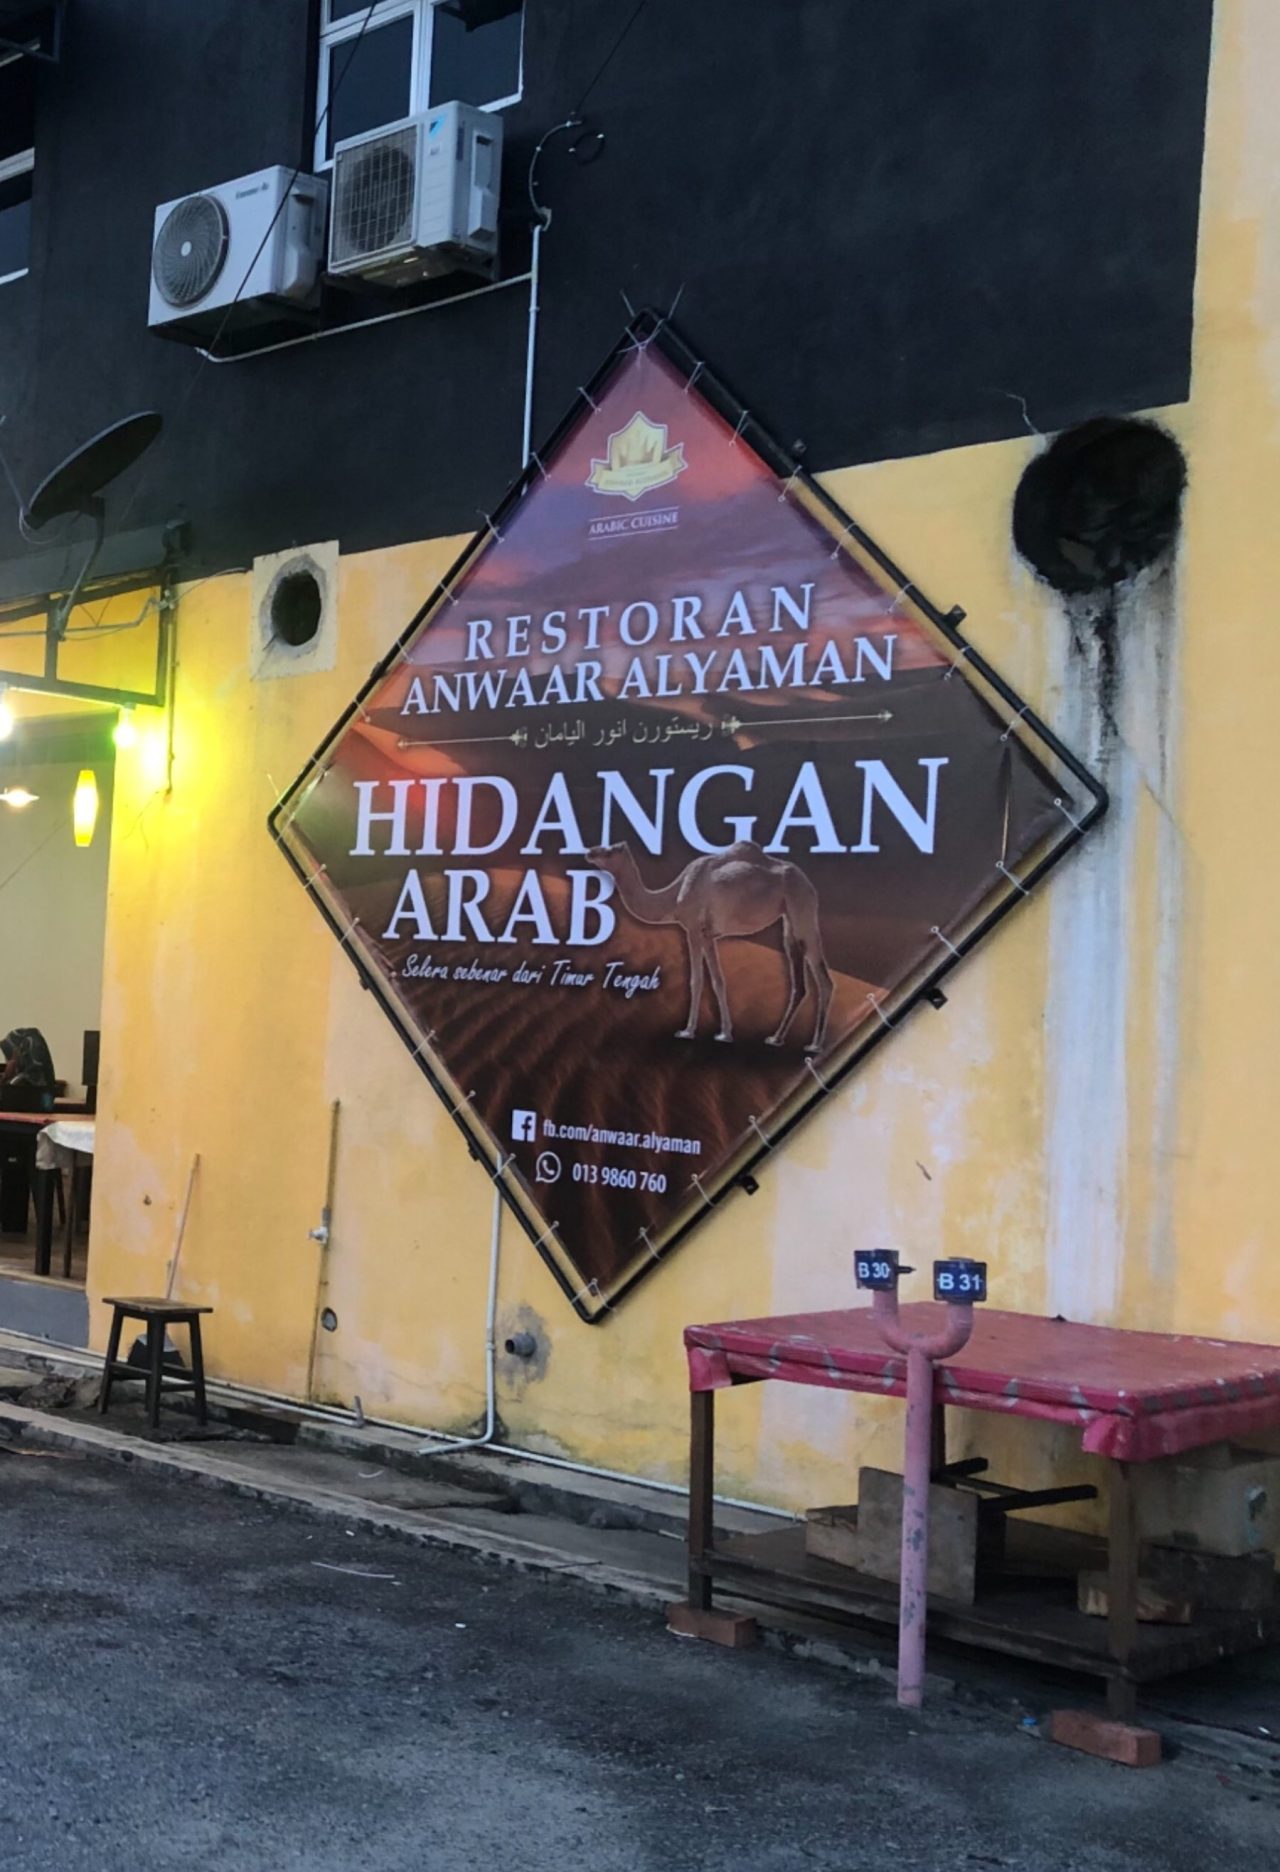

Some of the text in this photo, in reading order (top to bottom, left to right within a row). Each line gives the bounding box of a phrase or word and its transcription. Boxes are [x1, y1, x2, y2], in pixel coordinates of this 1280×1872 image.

[588, 511, 678, 536] ARABIC CUISINE
[464, 582, 815, 662] RESTORAN
[400, 634, 898, 716] ANWAAR ALYAMAN
[349, 757, 950, 857] HIDANGAN
[382, 867, 617, 947] ARAB
[401, 953, 662, 999] Selera sebenar dari Timur Tengah
[543, 1119, 702, 1155] fb.com/anwaar.alyaman
[572, 1162, 667, 1193] 013 9860 760
[858, 1262, 889, 1279] B 30
[939, 1273, 981, 1291] B 31
